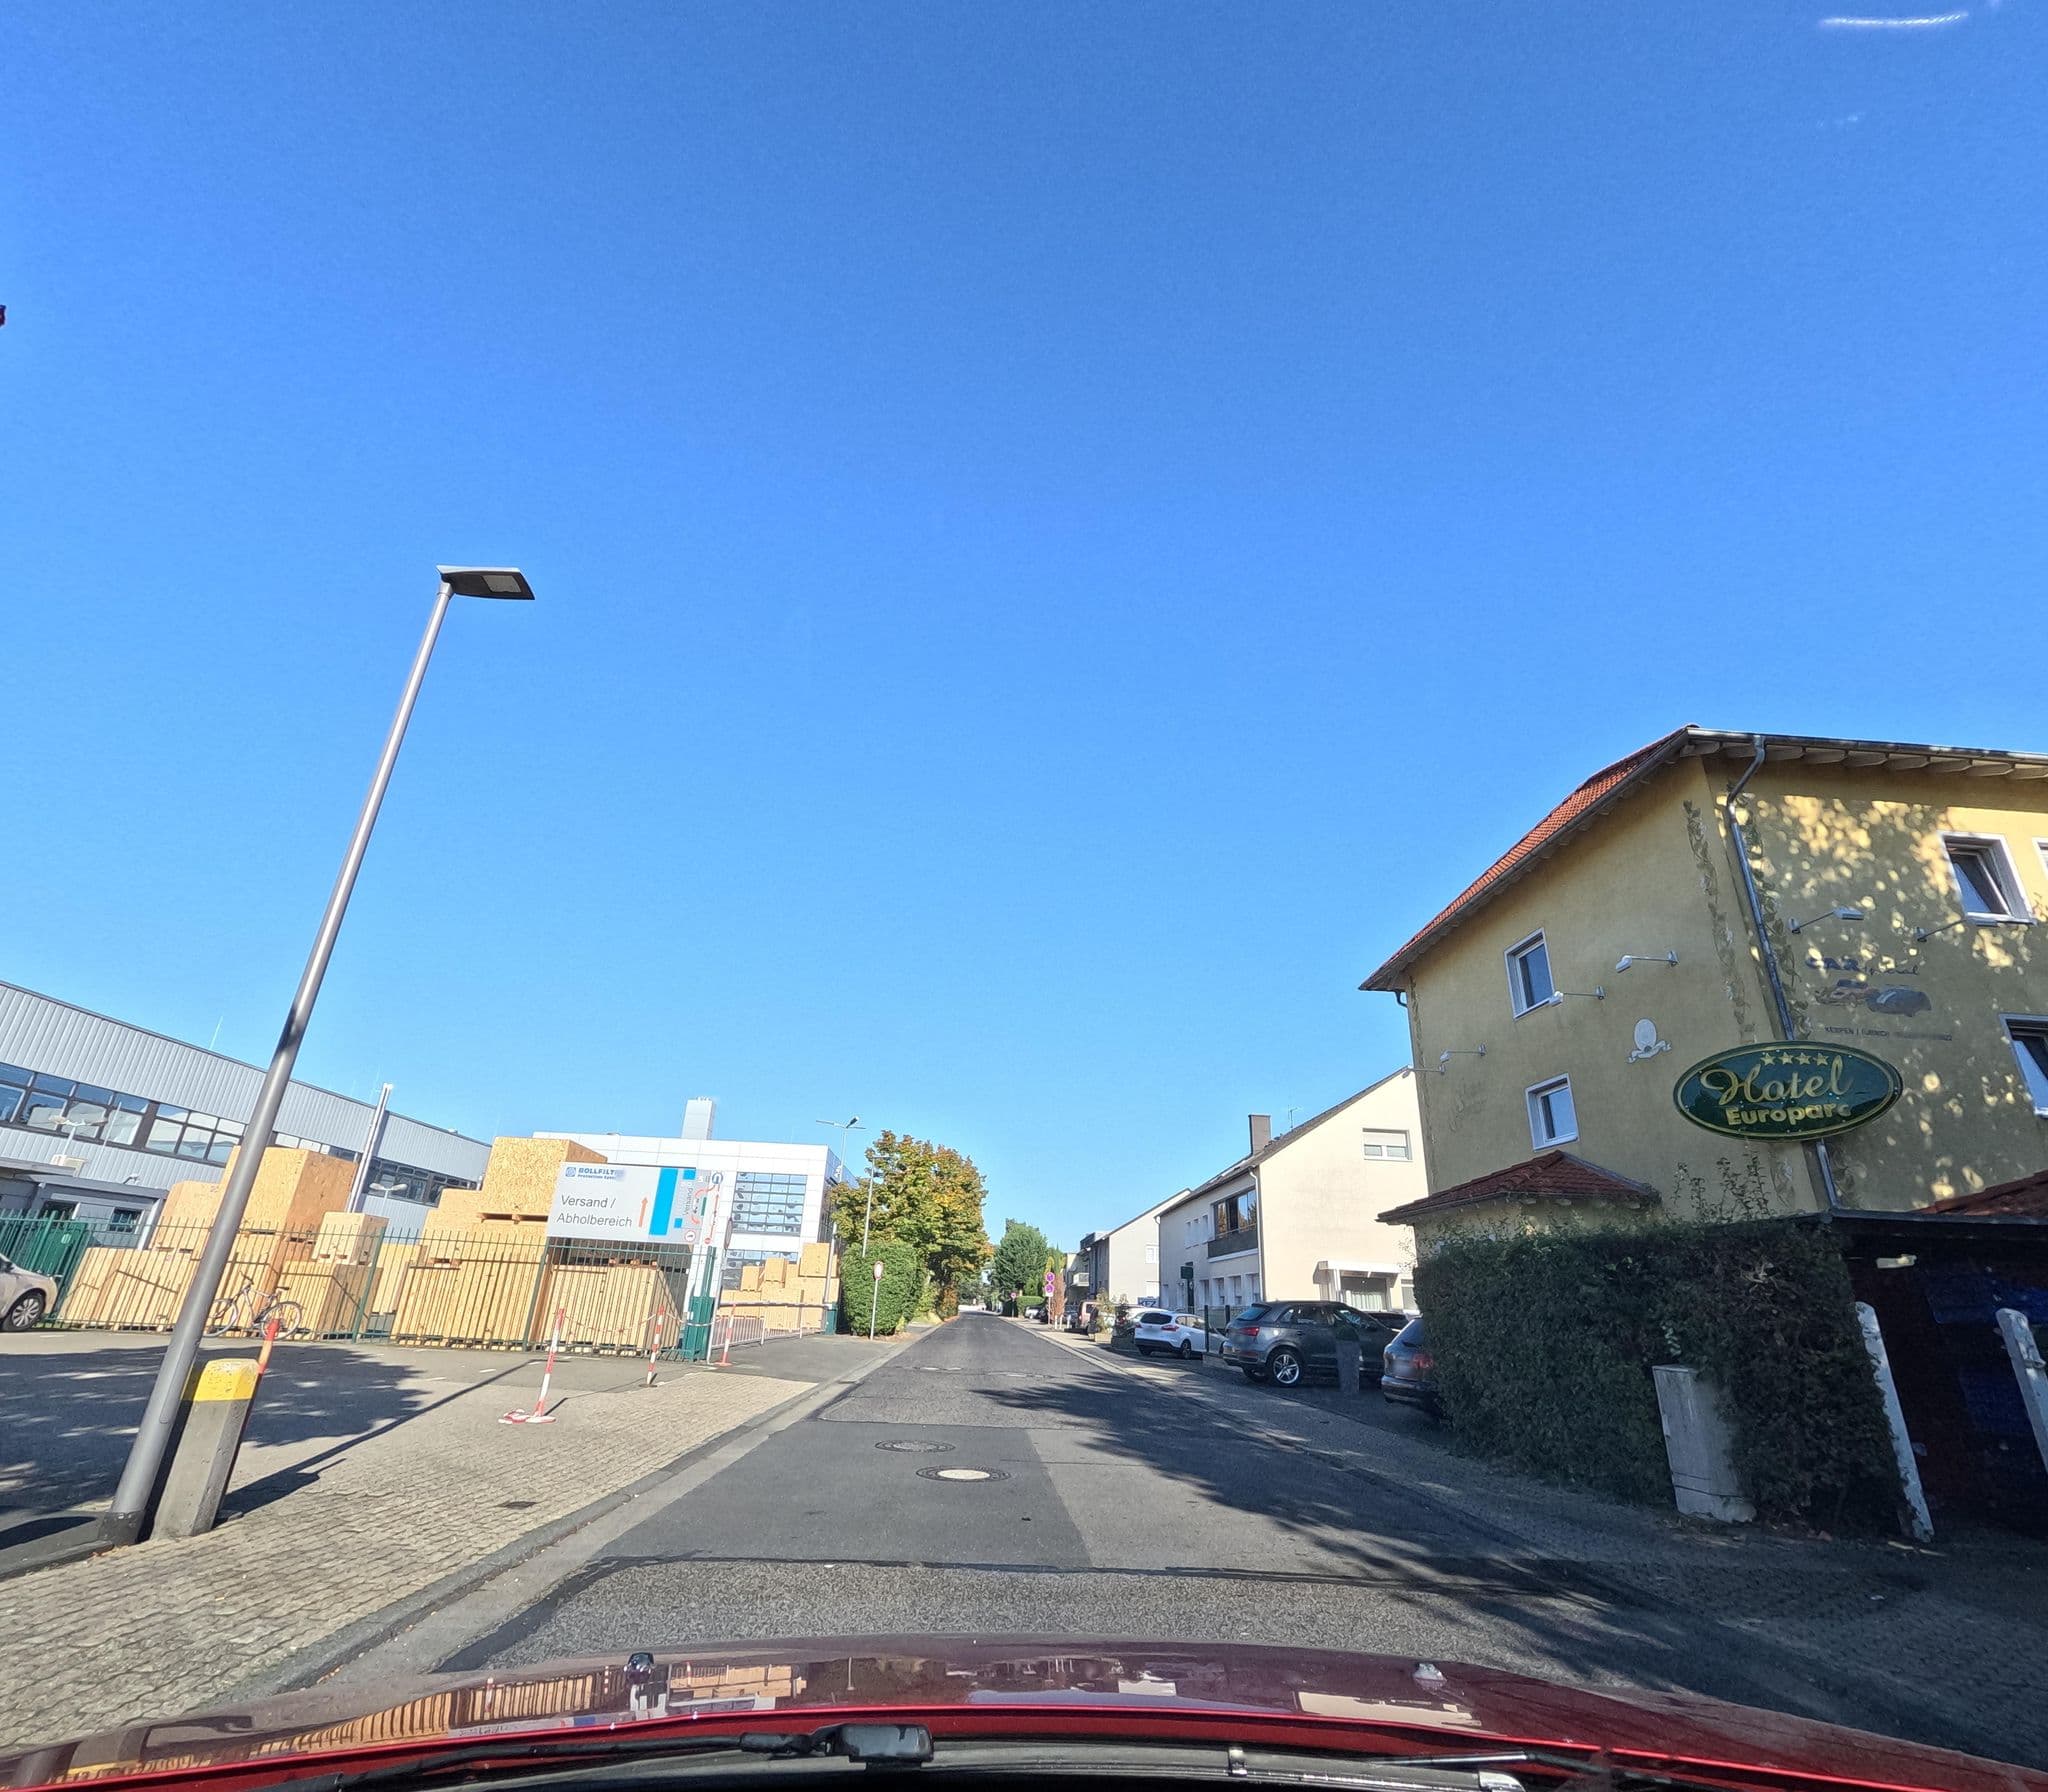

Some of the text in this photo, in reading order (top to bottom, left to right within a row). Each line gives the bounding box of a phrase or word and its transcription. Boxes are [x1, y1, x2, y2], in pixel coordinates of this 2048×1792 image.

[1700, 1054, 1851, 1106] Hotel
[1725, 1103, 1852, 1126] Europarc
[561, 1194, 608, 1209] Versand
[556, 1212, 633, 1228] Abholbereich
